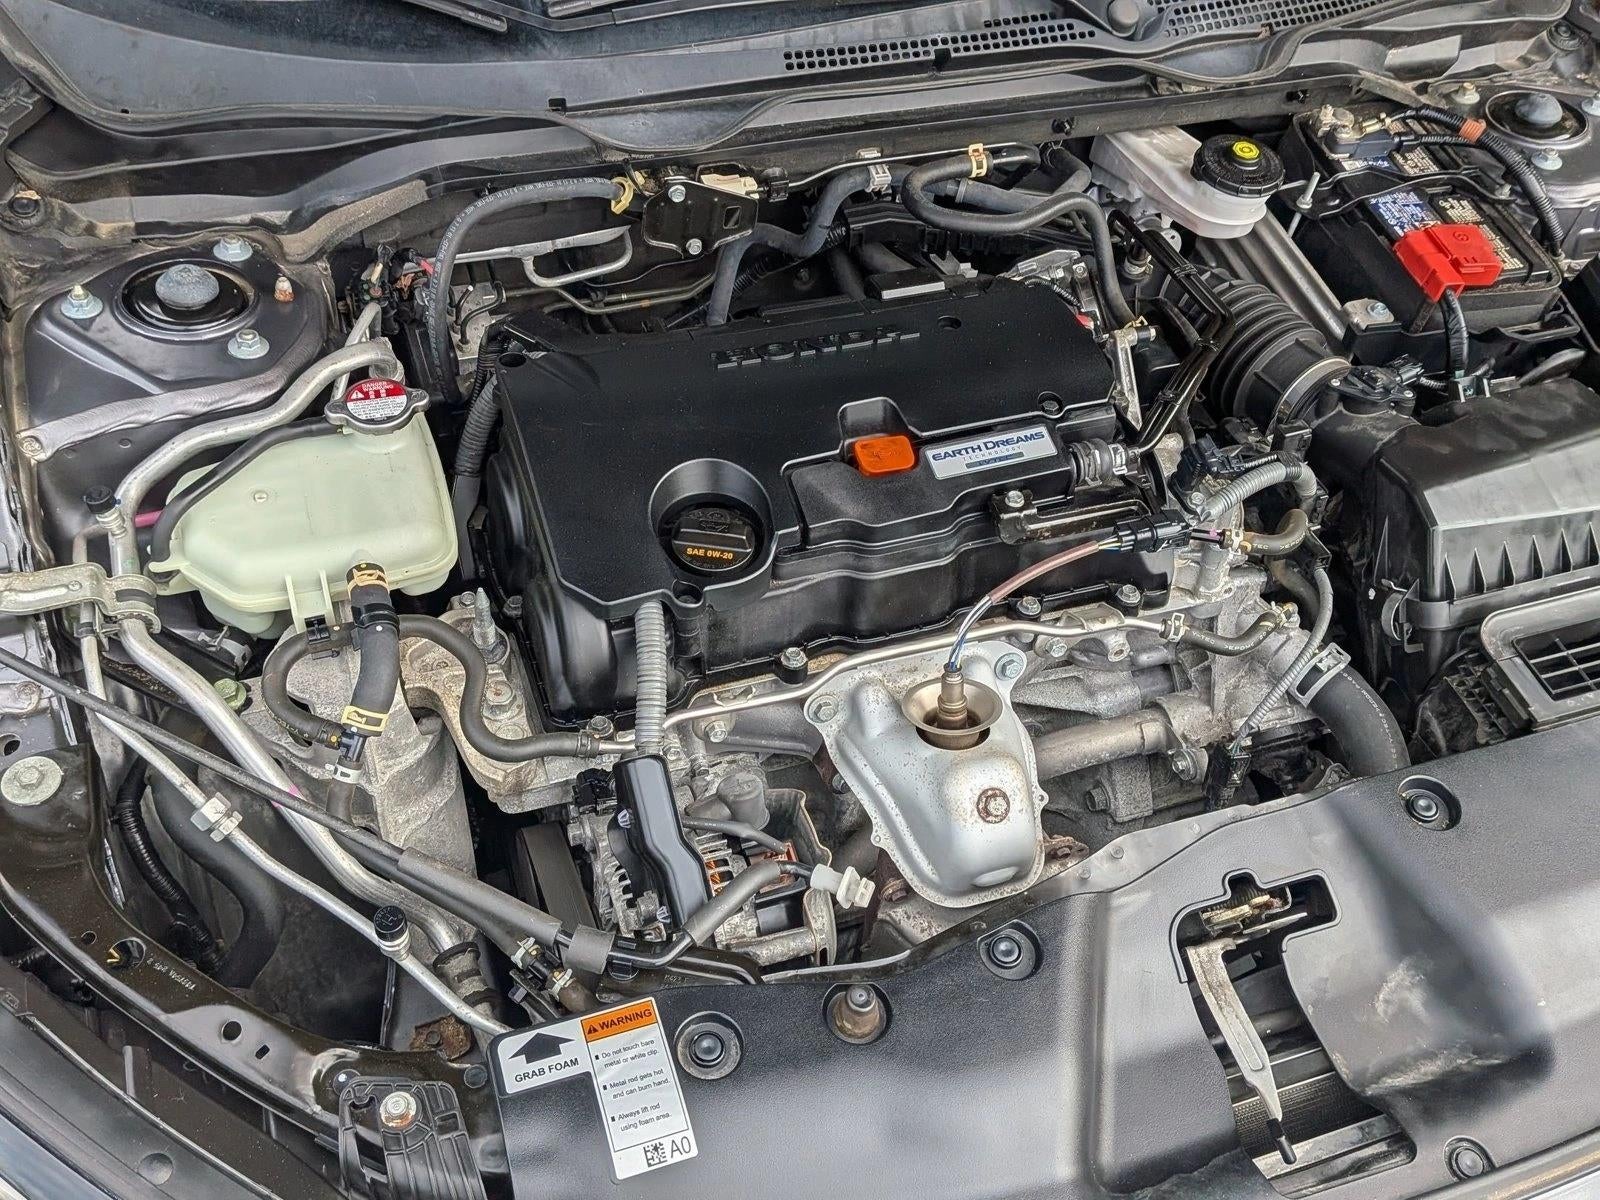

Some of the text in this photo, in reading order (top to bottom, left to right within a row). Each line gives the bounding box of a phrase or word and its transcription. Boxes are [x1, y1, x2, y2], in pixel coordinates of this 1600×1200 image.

[931, 431, 1045, 461] EARTH DREAMS
[963, 446, 1021, 461] TECHNOLOGY
[686, 547, 734, 560] SAE 0W-20
[599, 1008, 653, 1031] WARNING
[602, 1038, 655, 1059] Do not touch bare
[604, 1048, 660, 1069] metal or white clip.
[514, 1057, 580, 1084] GRAB FOAM
[609, 1068, 664, 1089] Metal rod gets hot
[613, 1088, 625, 1099] and
[625, 1086, 638, 1096] can
[653, 1077, 670, 1088] hand.
[618, 1102, 661, 1121] Always lift rod
[620, 1112, 672, 1132] using foam area.
[671, 1136, 692, 1158] A0
